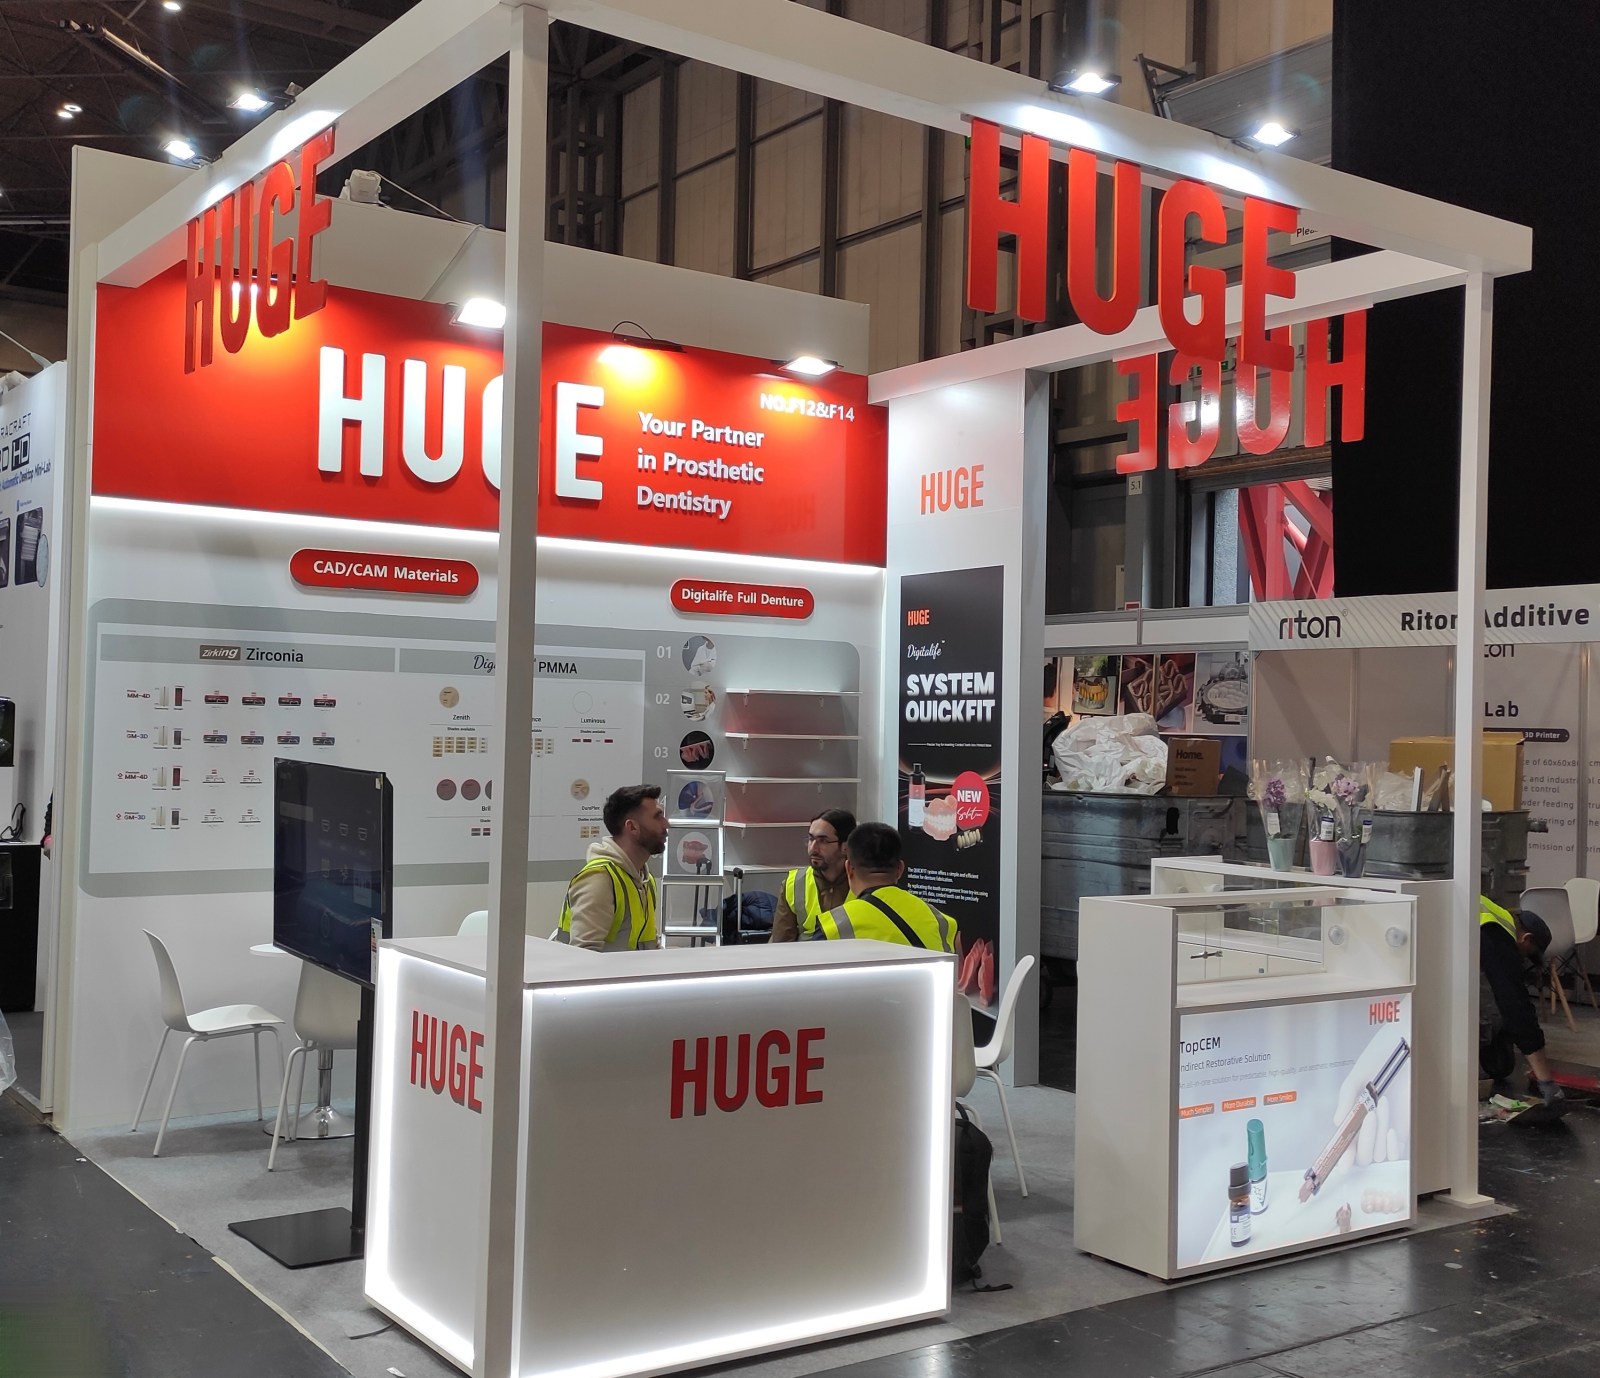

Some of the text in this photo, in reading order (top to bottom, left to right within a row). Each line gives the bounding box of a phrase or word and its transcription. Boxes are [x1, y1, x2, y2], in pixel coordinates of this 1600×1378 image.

[184, 126, 335, 375] HUGE
[967, 117, 1298, 372] HUGE
[638, 411, 765, 448] Your Partner
[637, 448, 765, 483] in Prosthetic
[637, 484, 732, 520] Dentistry
[920, 464, 985, 516] HUGE
[313, 560, 459, 585] CAD/CAM Materials
[681, 588, 804, 608] Digitalife Full Denture
[908, 609, 930, 626] HUGE
[1279, 610, 1342, 640] riton
[202, 647, 304, 663] Zirking Zirconia
[656, 645, 672, 659] 01
[538, 661, 578, 674] PMMA
[906, 672, 995, 697] SYSTEM
[655, 693, 670, 705] 02
[1535, 731, 1561, 739] Printer
[653, 746, 669, 758] 03
[957, 789, 982, 804] NEW
[1369, 1000, 1401, 1026] HUGE
[1180, 1036, 1221, 1056] TopCEM
[410, 1010, 484, 1115] HUGE
[669, 1027, 826, 1120] HUGE
[1180, 1052, 1272, 1073] ndirect Restorative Solution
